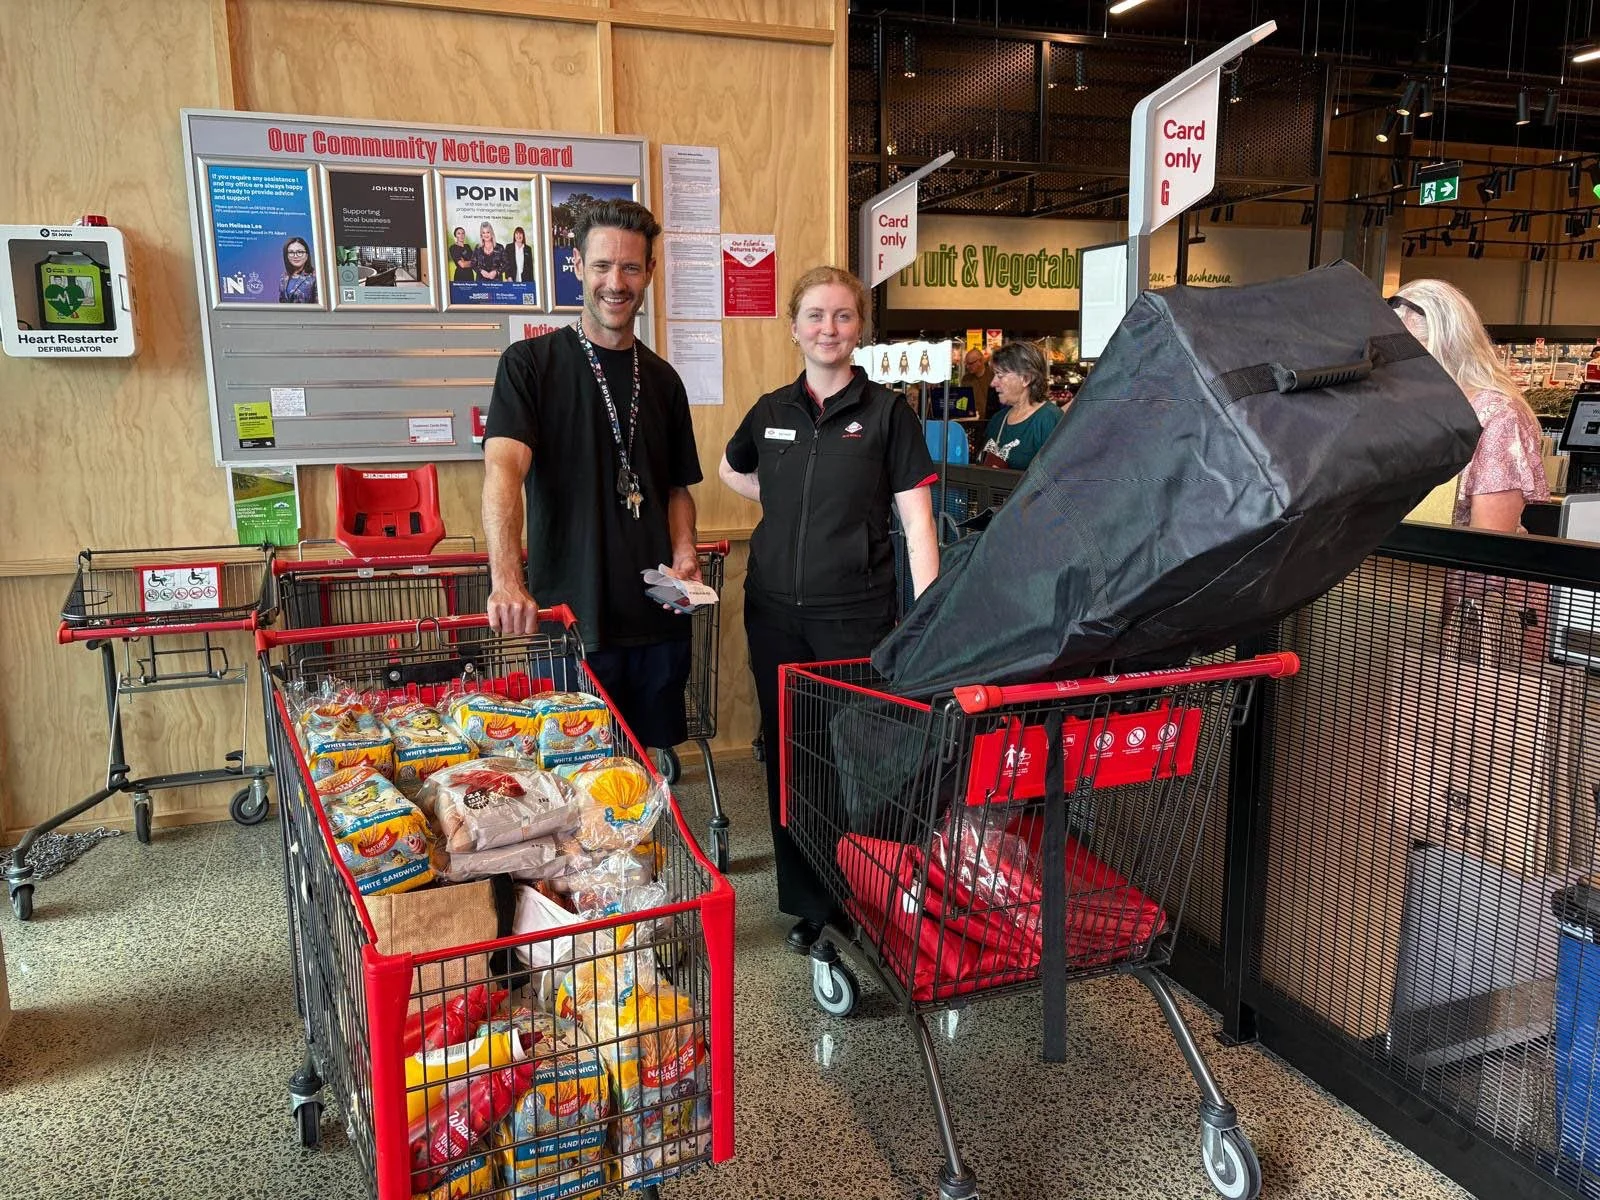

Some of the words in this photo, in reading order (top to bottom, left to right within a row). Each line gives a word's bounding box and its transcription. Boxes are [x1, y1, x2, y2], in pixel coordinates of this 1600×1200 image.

[1163, 119, 1205, 141] Card
[268, 127, 307, 153] Our
[312, 130, 437, 165] Community
[442, 138, 510, 164] Notice
[515, 142, 573, 168] Board
[1164, 147, 1202, 173] only
[455, 185, 497, 201] POP
[499, 187, 519, 202] IN
[1161, 179, 1170, 206] G
[342, 207, 381, 216] Supporting
[879, 214, 908, 228] Card
[880, 232, 906, 249] only
[878, 254, 884, 271] F
[900, 244, 958, 288] ruit
[962, 244, 979, 288] &
[18, 334, 56, 345] Heart
[57, 334, 119, 345] Restarter
[523, 323, 561, 340] Noti
[38, 345, 102, 353] DEFIBRILLATOR
[323, 742, 346, 750] WHITE
[405, 748, 427, 758] WHITE
[427, 745, 463, 755] SANDWICH
[552, 756, 573, 764] WHITE
[574, 752, 606, 761] SANDWICH
[358, 881, 382, 892] WHITE
[382, 864, 423, 885] SANDWICH
[438, 1132, 462, 1157] TOMATO
